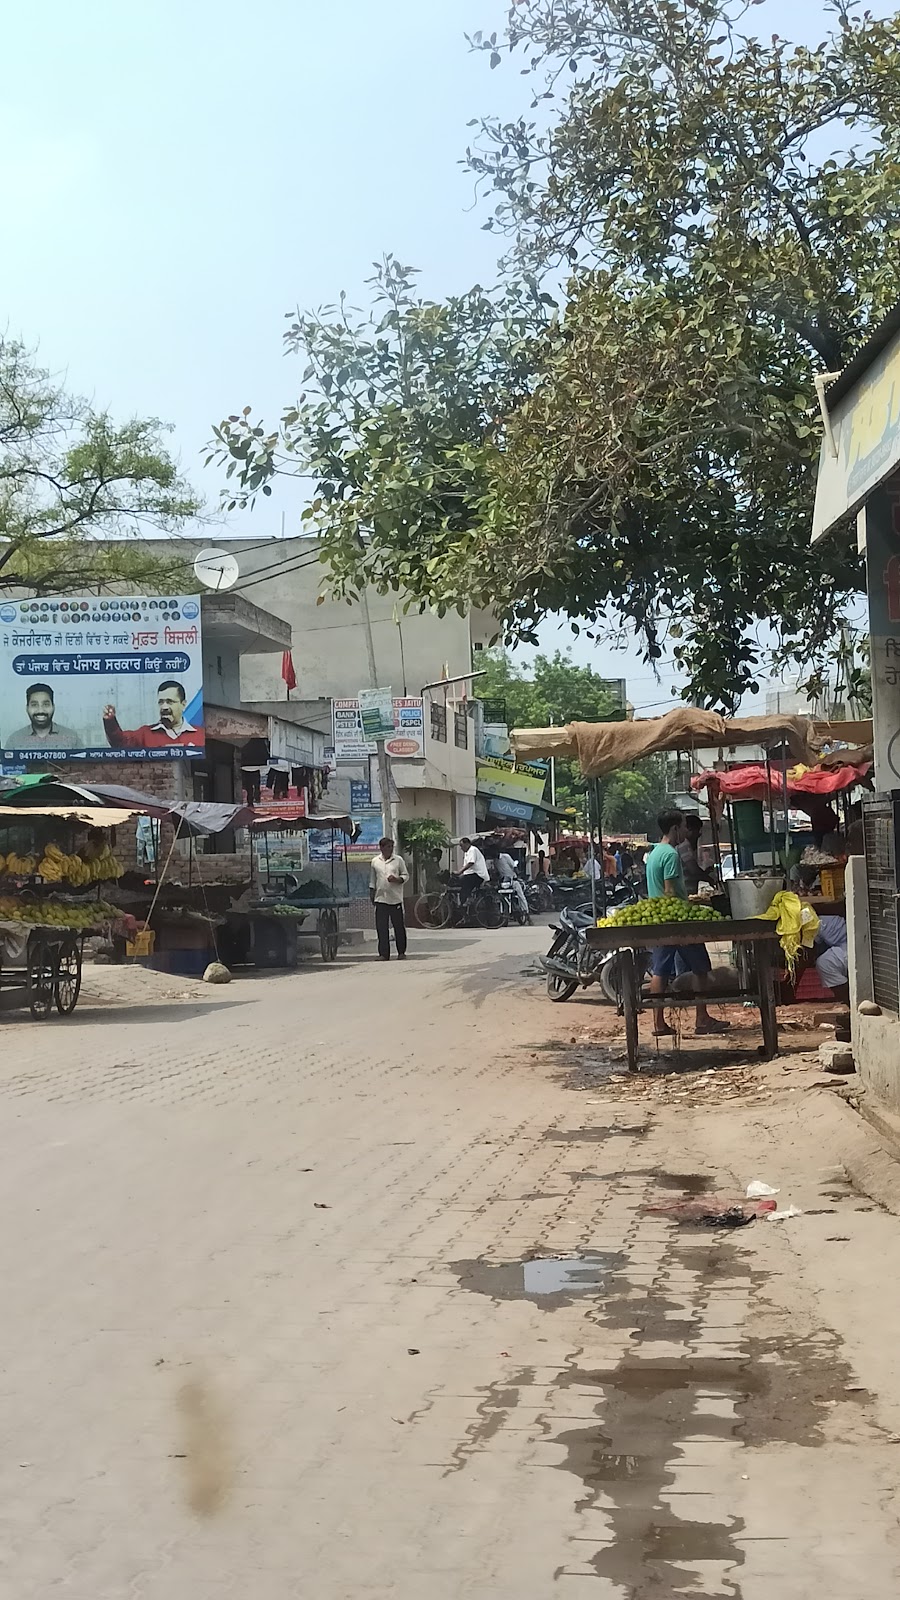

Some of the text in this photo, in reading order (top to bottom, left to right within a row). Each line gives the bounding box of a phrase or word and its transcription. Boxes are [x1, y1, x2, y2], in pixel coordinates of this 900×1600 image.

[12, 629, 52, 647] ਕੇਜਰੀਵਾਲ
[54, 632, 62, 646] ਜੀ
[65, 632, 83, 646] ਦਿੱਲੀ
[103, 631, 110, 646] ਦੇ
[112, 631, 129, 646] ਸਕਦੇ
[164, 625, 198, 646] ਬਿਜਲੀ
[28, 659, 50, 673] ਪੰਜਾਬ
[52, 659, 70, 673] ਵਿੱਚ
[73, 655, 101, 672] ਪੰਜਾਬ
[104, 658, 142, 671] ਸਰਕਾਰ
